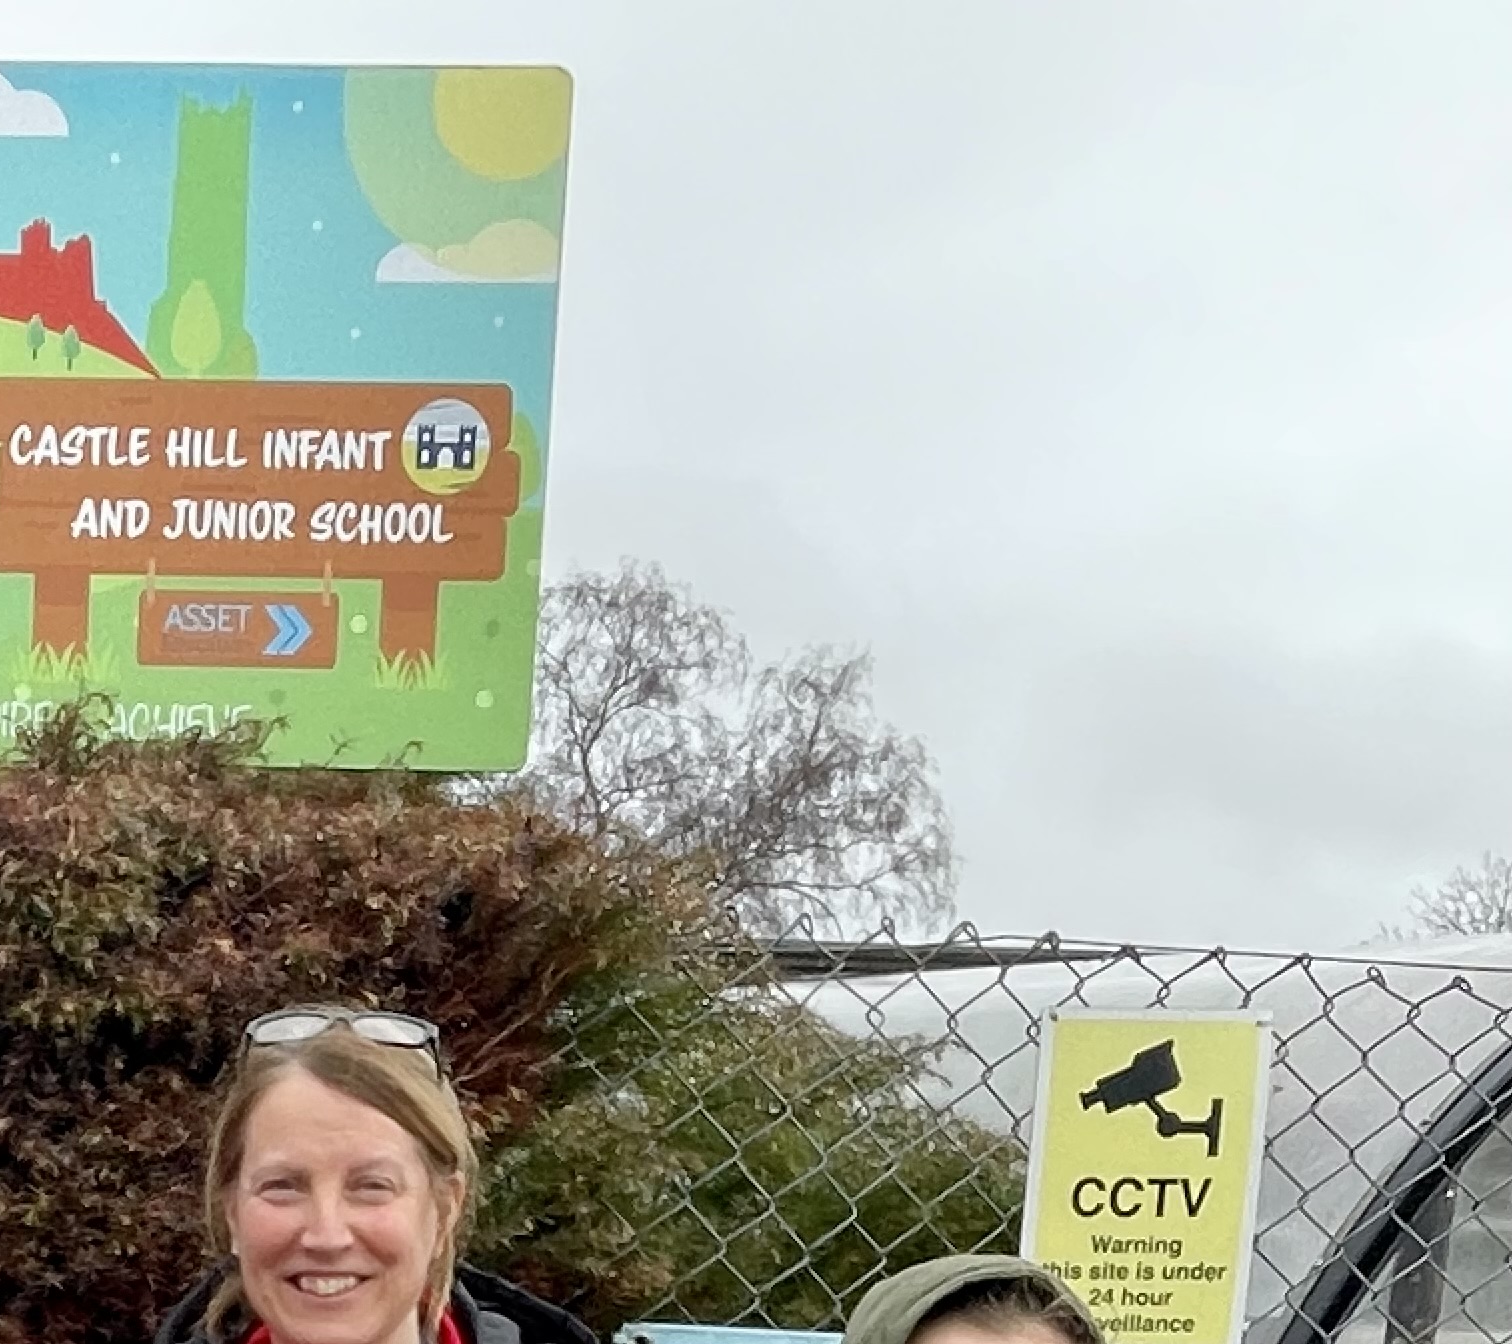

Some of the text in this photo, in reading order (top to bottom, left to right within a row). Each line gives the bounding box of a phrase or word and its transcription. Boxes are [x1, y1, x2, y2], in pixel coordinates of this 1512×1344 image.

[10, 424, 390, 471] CASTLE HILL INFANT
[71, 498, 453, 543] AND JUNIOR SCHOOL
[163, 602, 253, 634] ASSET
[1072, 1177, 1213, 1218] CCTV
[1091, 1235, 1182, 1257] Warning
[1089, 1261, 1129, 1280] site
[1135, 1261, 1155, 1280] is
[1162, 1261, 1227, 1280] under
[1088, 1287, 1174, 1306] 24 hour
